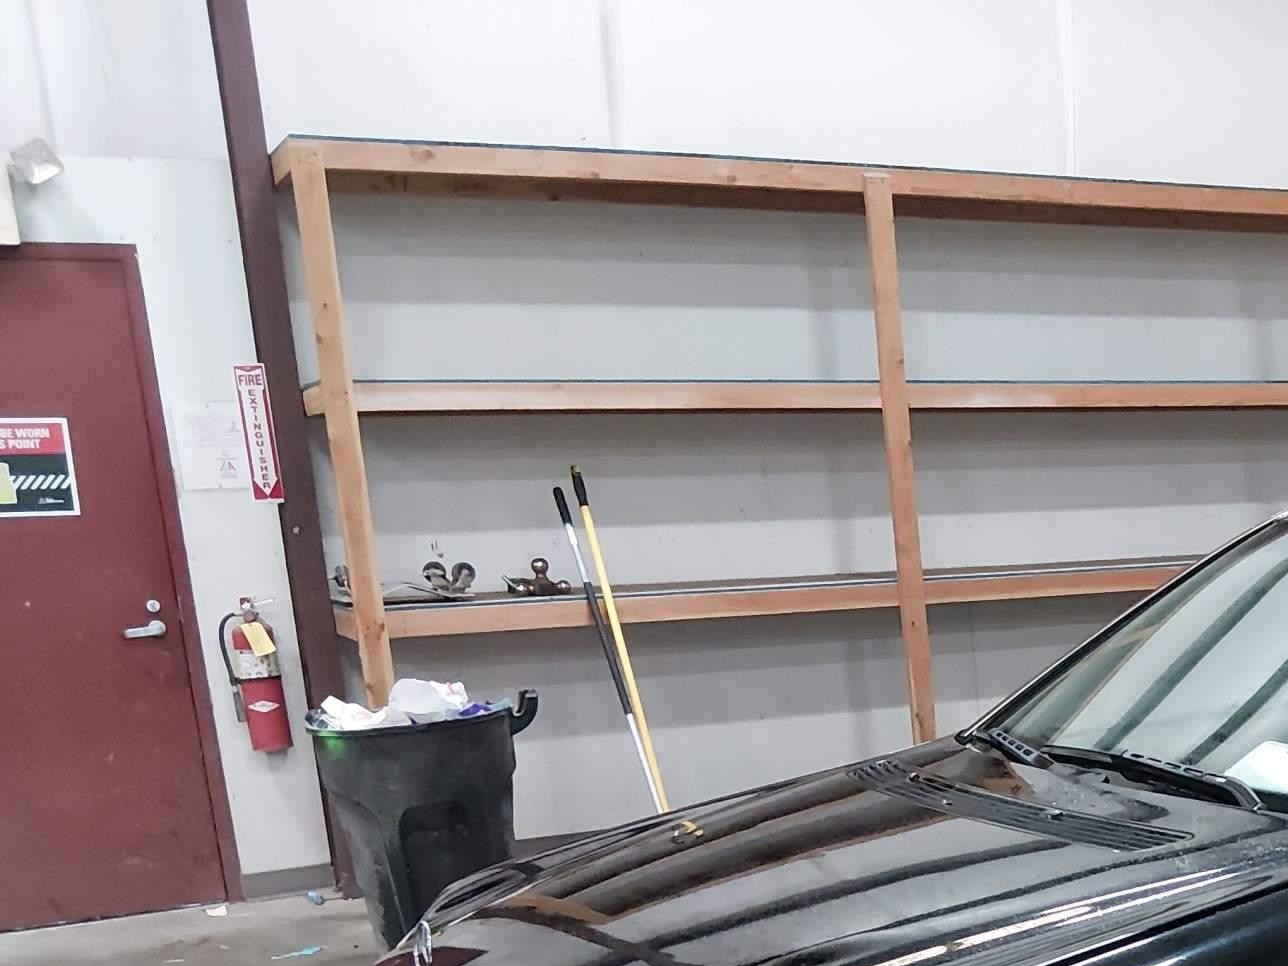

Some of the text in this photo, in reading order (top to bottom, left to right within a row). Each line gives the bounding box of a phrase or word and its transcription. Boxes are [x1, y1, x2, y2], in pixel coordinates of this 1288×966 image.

[238, 374, 262, 386] FIRE
[15, 428, 50, 438] WORN
[8, 439, 40, 449] POINT
[248, 389, 271, 489] EXTINGUISHER
